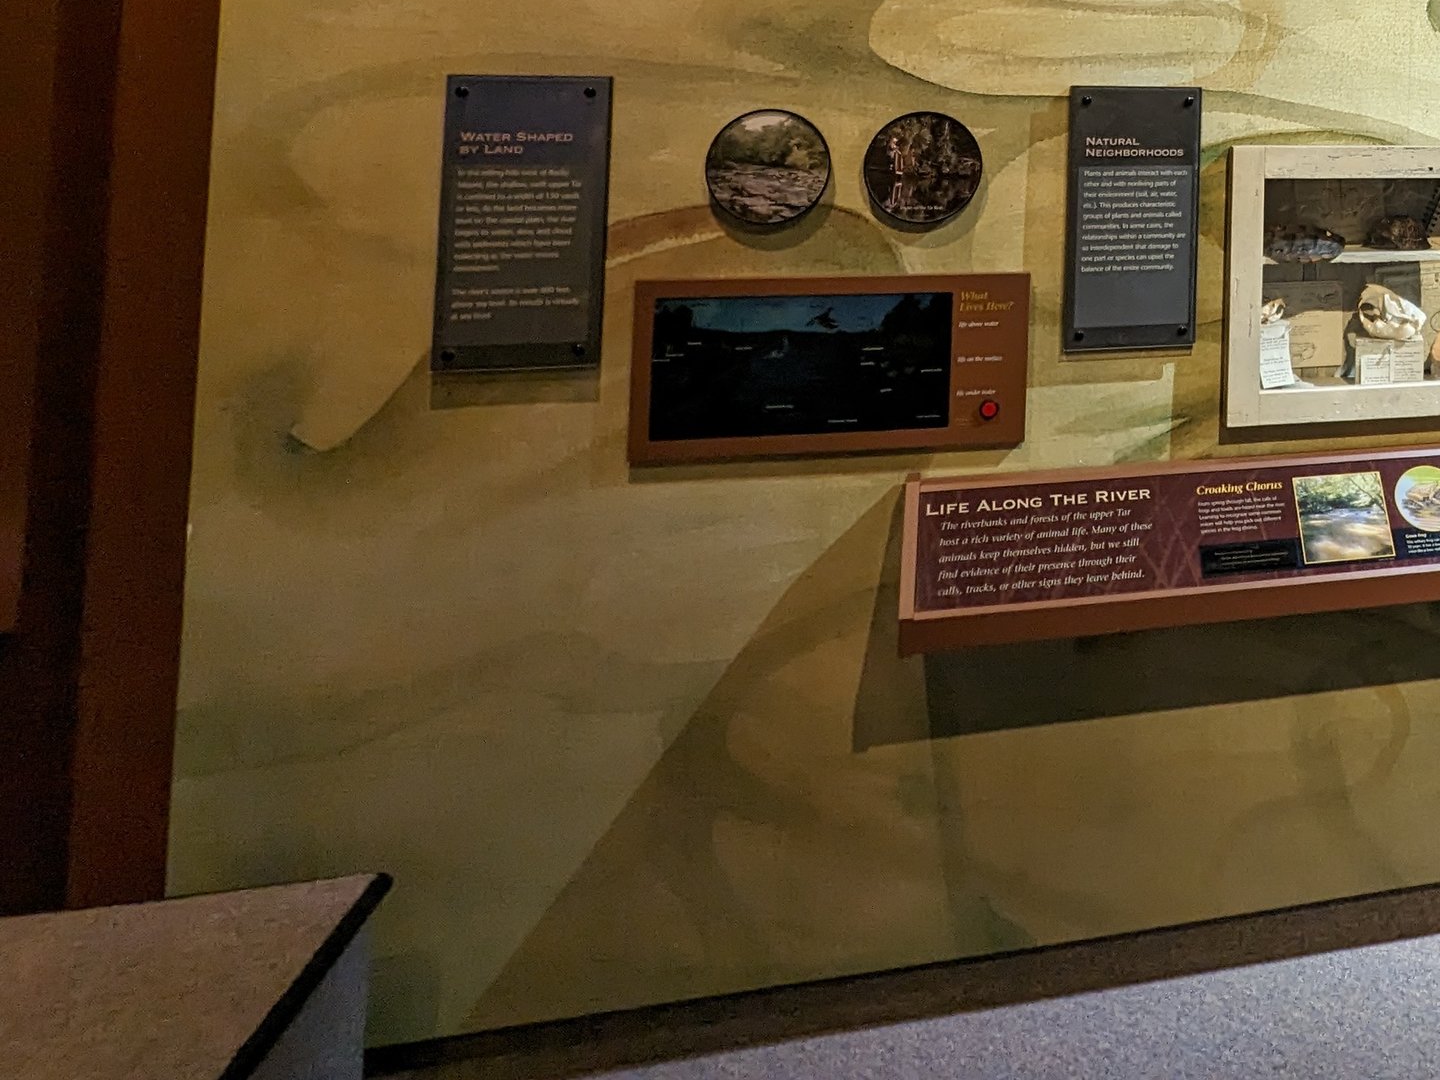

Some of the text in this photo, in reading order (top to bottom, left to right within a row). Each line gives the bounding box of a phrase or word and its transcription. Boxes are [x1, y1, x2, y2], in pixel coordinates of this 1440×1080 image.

[461, 132, 573, 142] WATER SHAPED
[1086, 137, 1139, 146] NATURAL
[460, 145, 523, 154] BY LAND
[1085, 149, 1184, 157] NEIGHBORHOODS
[1196, 481, 1283, 495] Croaking Chorus
[926, 489, 1151, 516] LIFE ALONG THE RIVER
[940, 508, 1131, 531] The riverbanks and forests of the upper Tar
[939, 538, 959, 547] host
[971, 535, 989, 544] rich
[993, 533, 1024, 543] variety
[1025, 530, 1034, 541] of
[1037, 528, 1069, 539] animal
[1071, 526, 1089, 538] life.
[1092, 523, 1117, 534] Many
[1119, 522, 1129, 533] of
[1131, 522, 1153, 531] these
